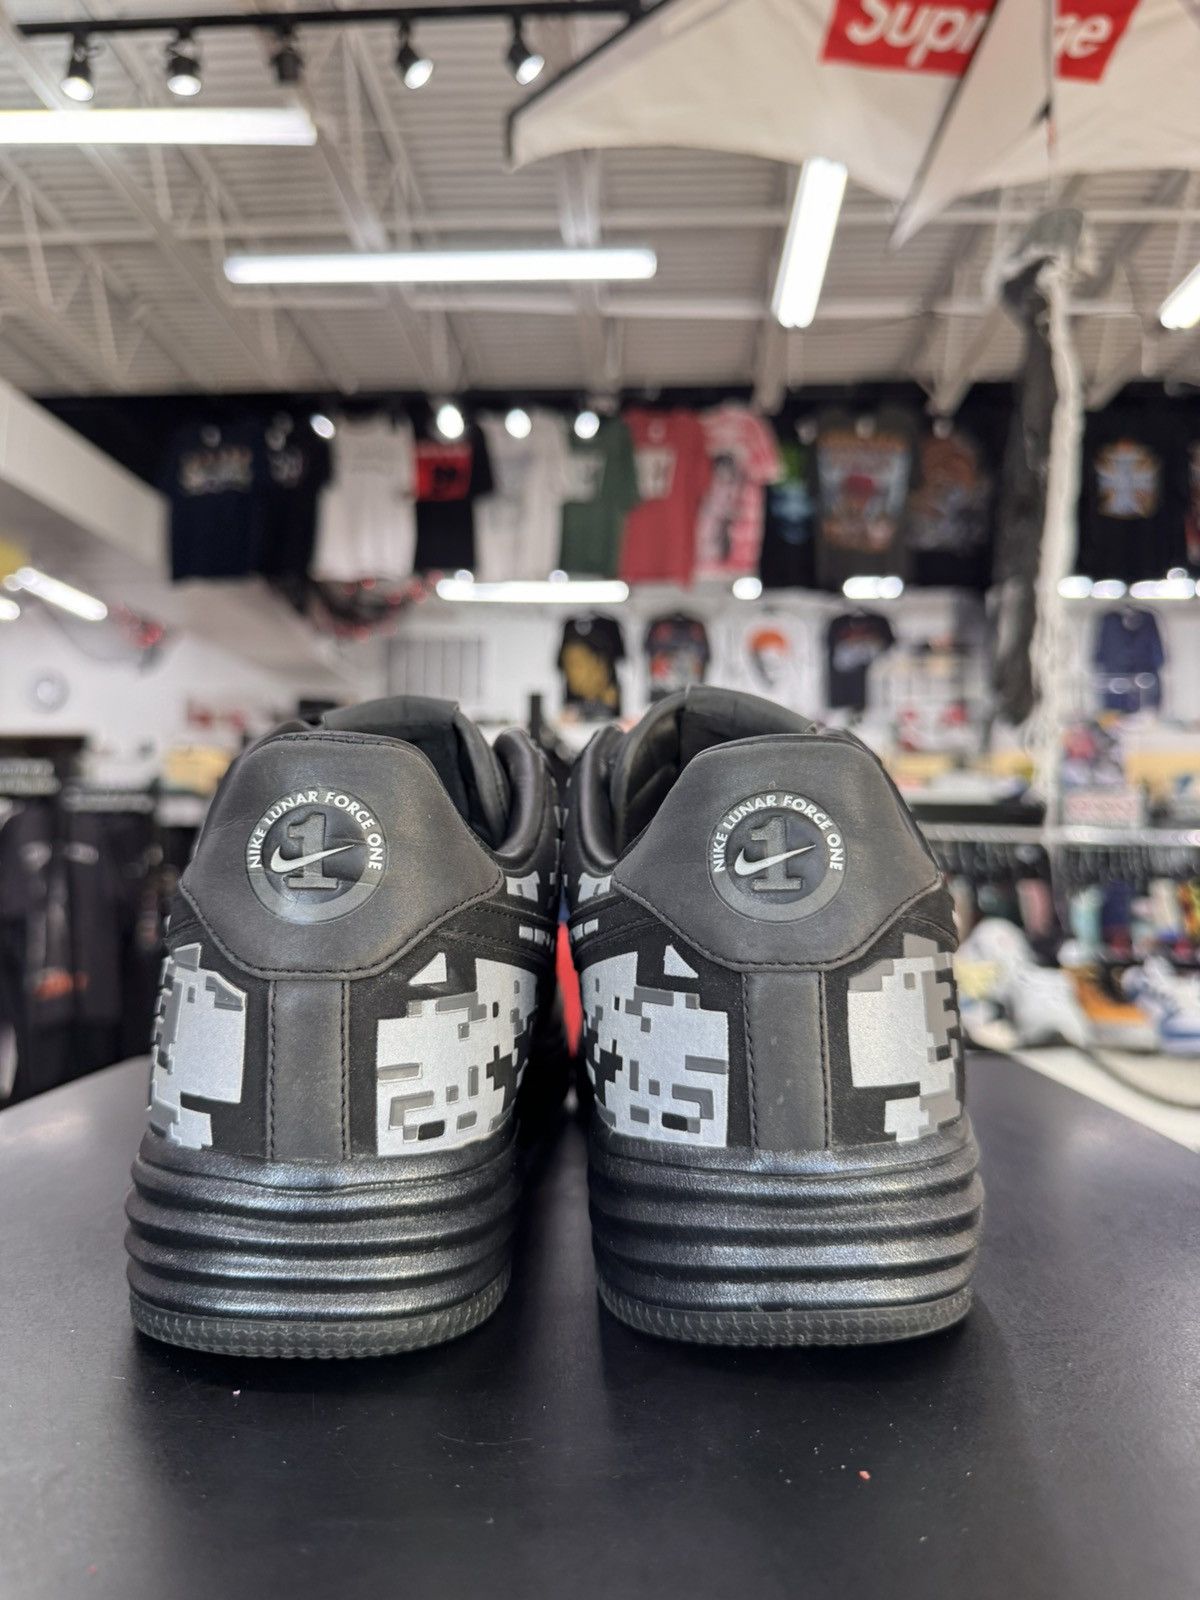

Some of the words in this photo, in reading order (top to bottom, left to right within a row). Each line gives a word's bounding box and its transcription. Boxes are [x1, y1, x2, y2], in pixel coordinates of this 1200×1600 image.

[249, 829, 266, 869] NIKE
[264, 791, 318, 825] LUNAR
[325, 792, 375, 829] FORCE
[367, 833, 383, 870] ONE
[713, 833, 728, 872] NIKE
[723, 795, 777, 829] LUNAR
[783, 795, 833, 830] FORCE
[827, 833, 843, 871] ONE
